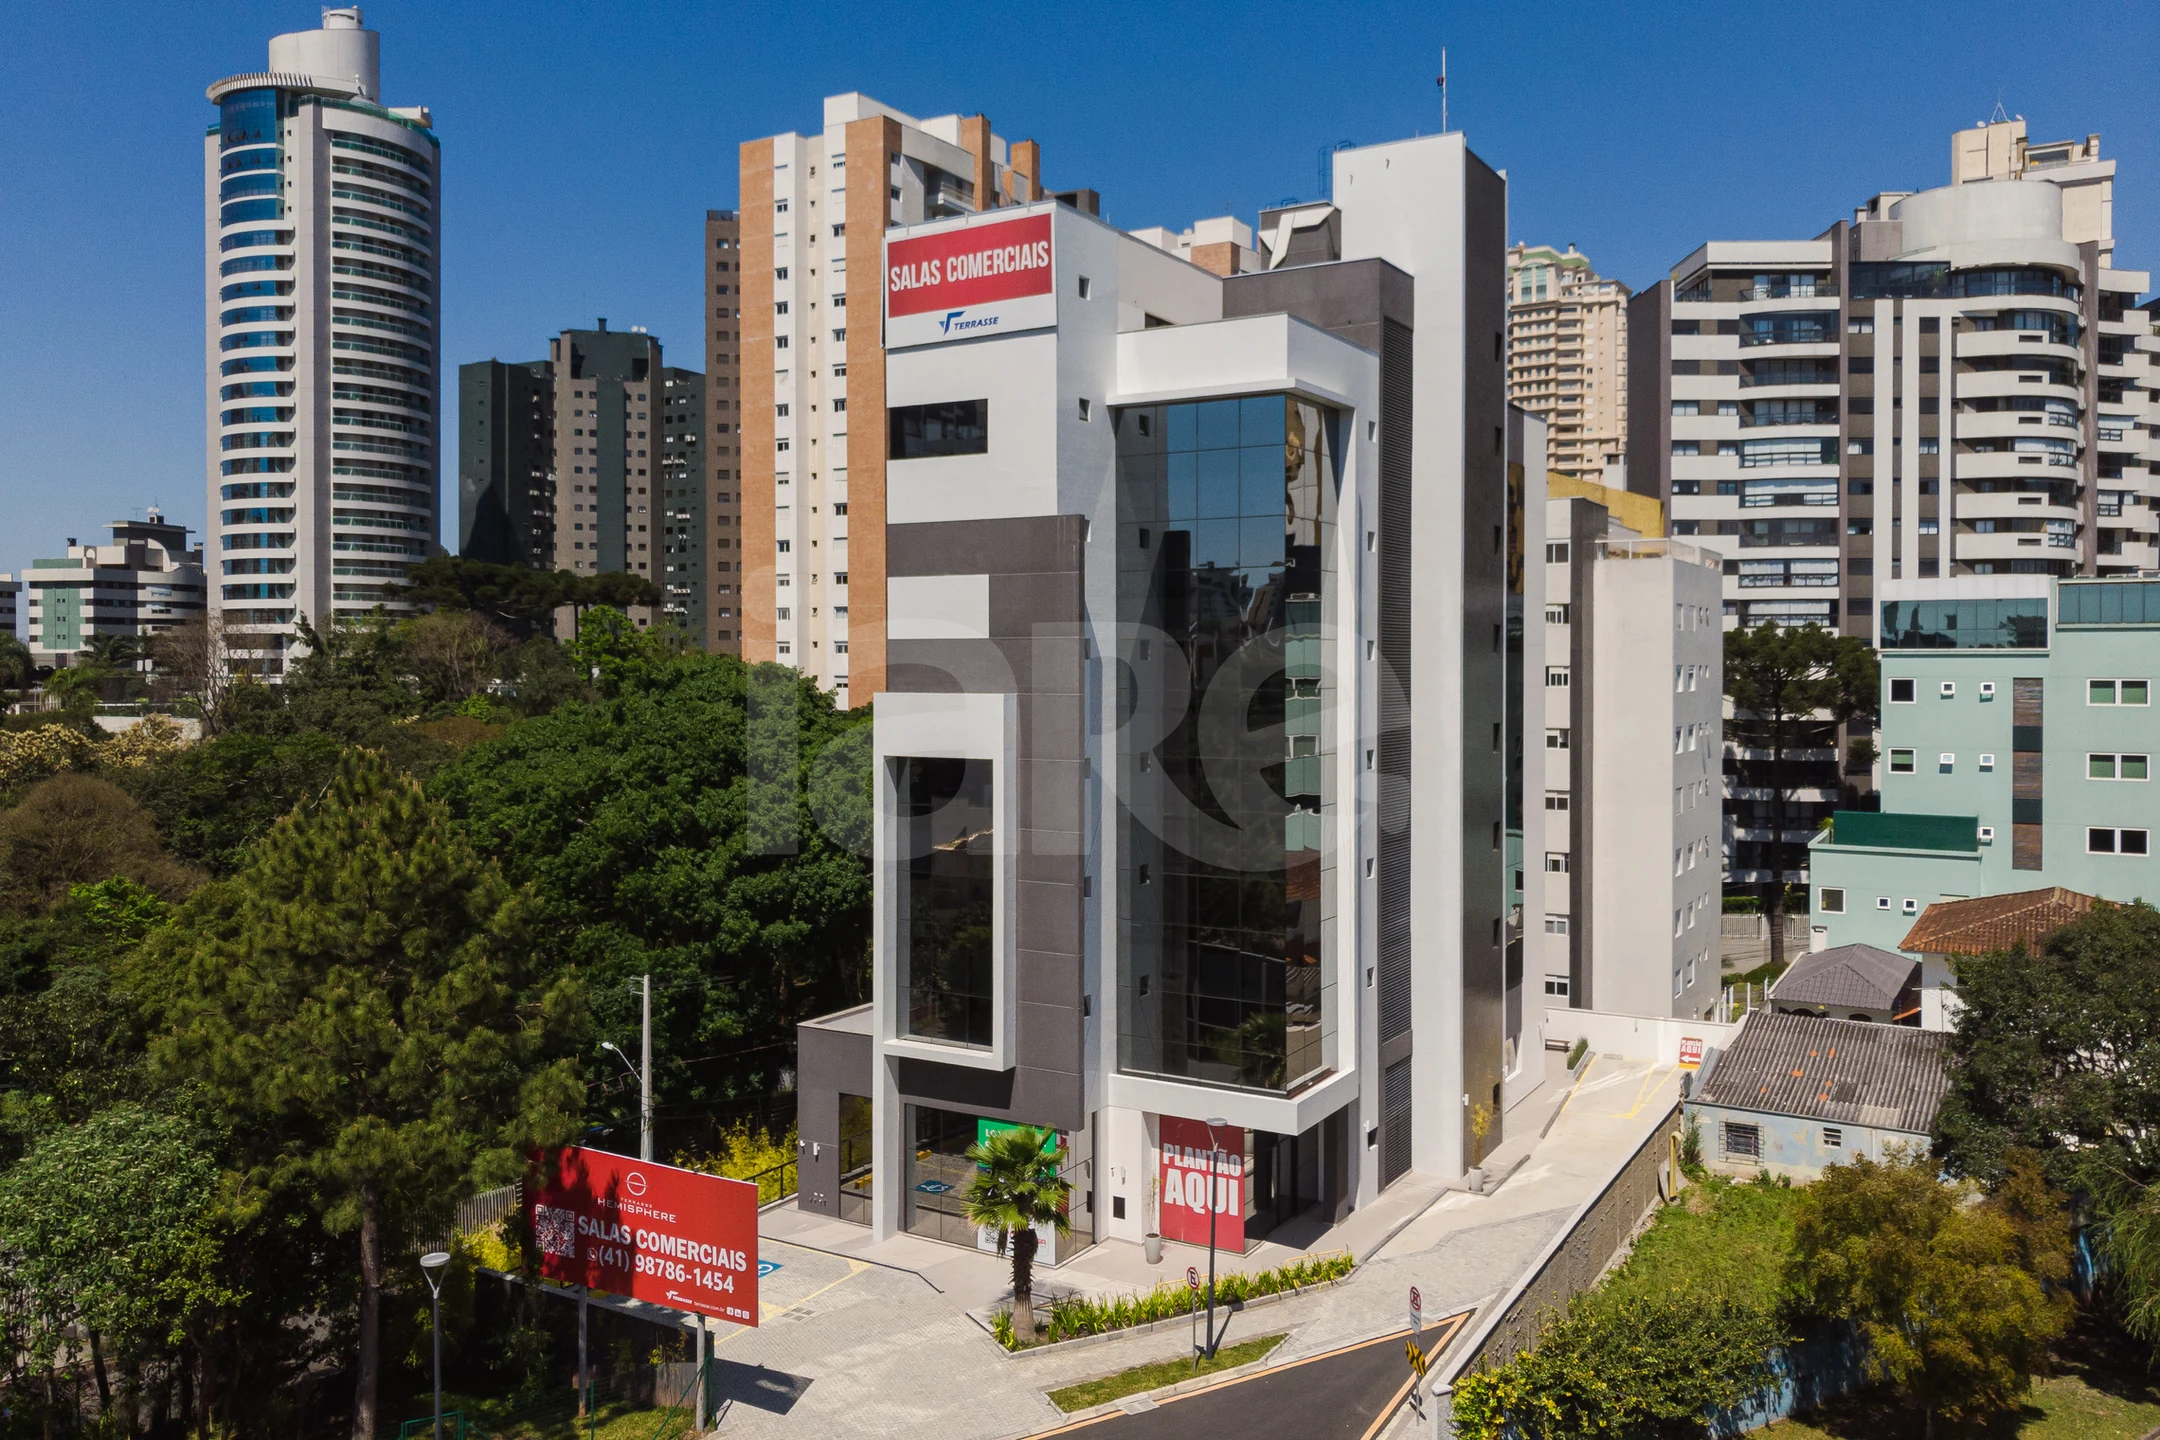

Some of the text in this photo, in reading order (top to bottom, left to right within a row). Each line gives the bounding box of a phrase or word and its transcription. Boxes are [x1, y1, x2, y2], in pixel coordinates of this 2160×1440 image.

[890, 241, 1049, 292] SALAS COMERCIAIS
[953, 316, 999, 331] TERRASSE
[1681, 1045, 1701, 1054] AQUI
[1163, 1143, 1242, 1177] PLANTÃO
[597, 1197, 677, 1224] HEMISPHERE
[1164, 1168, 1239, 1216] AQUI
[577, 1215, 747, 1272] SALAS COMERCIAIS
[599, 1245, 734, 1294] (41) 98786-1454
